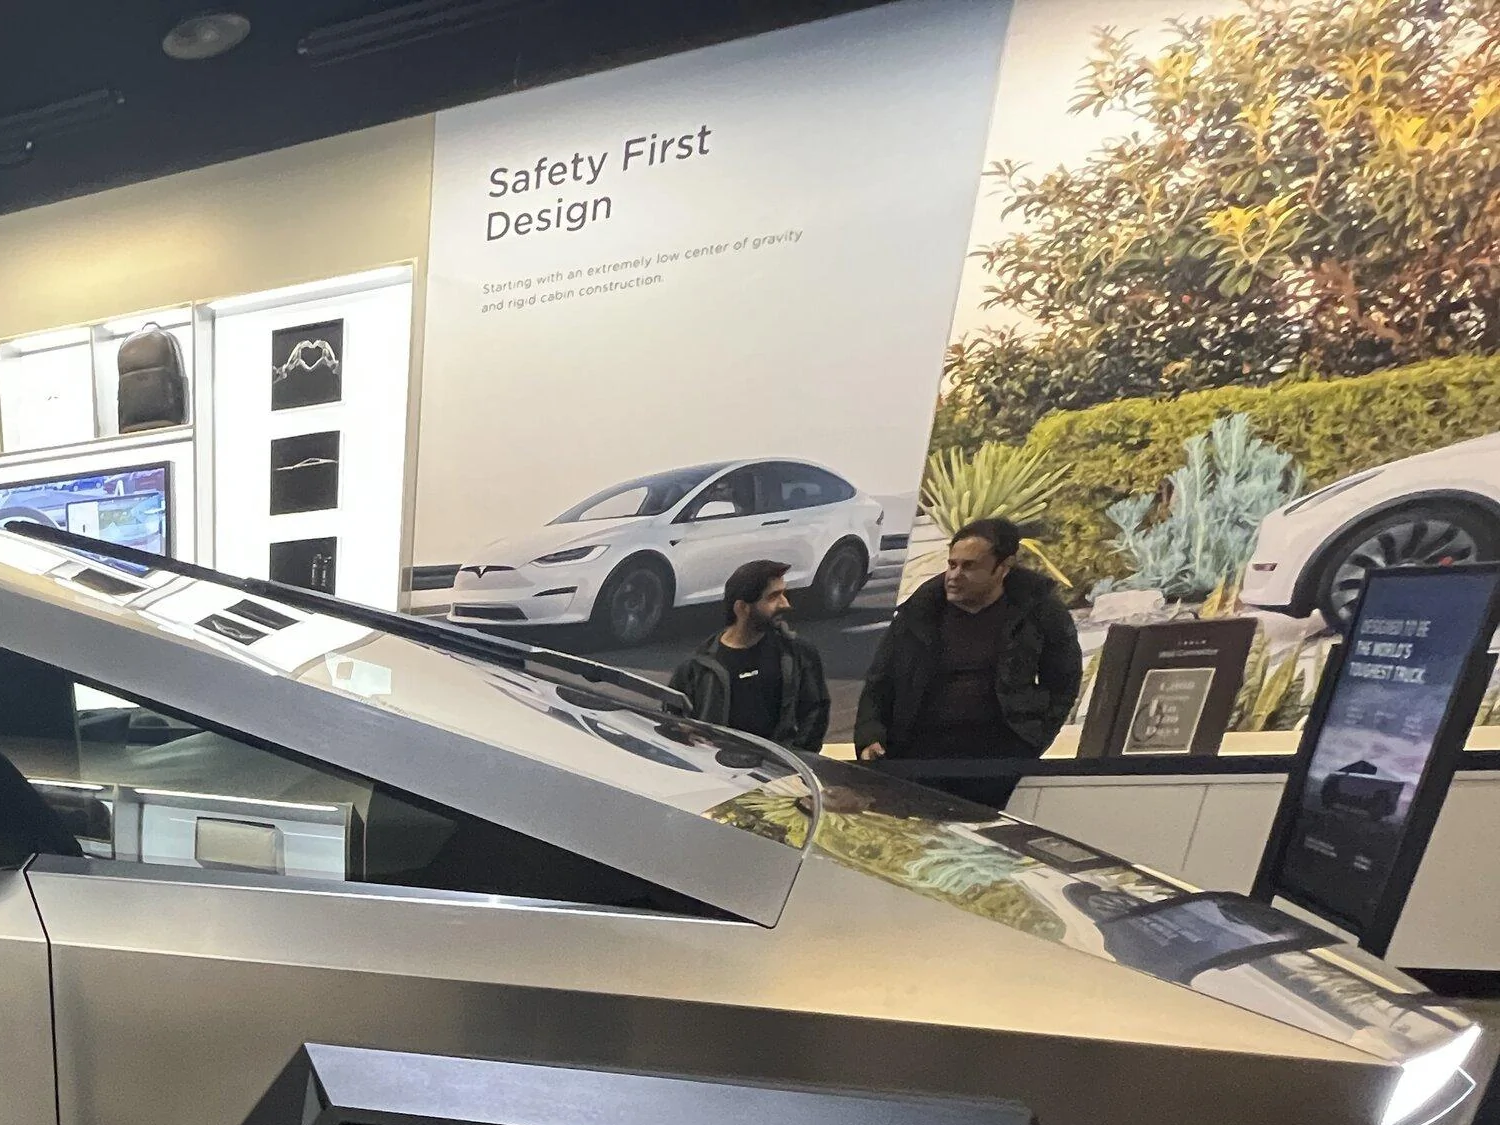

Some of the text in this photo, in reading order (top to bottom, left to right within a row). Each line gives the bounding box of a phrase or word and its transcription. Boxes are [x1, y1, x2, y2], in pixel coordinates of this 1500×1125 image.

[488, 124, 712, 198] Safety First
[486, 196, 612, 242] Design
[482, 229, 803, 295] Starting with an extremely low center of gravity
[481, 300, 504, 313] and
[507, 294, 537, 309] rigid
[540, 289, 575, 303] cabin
